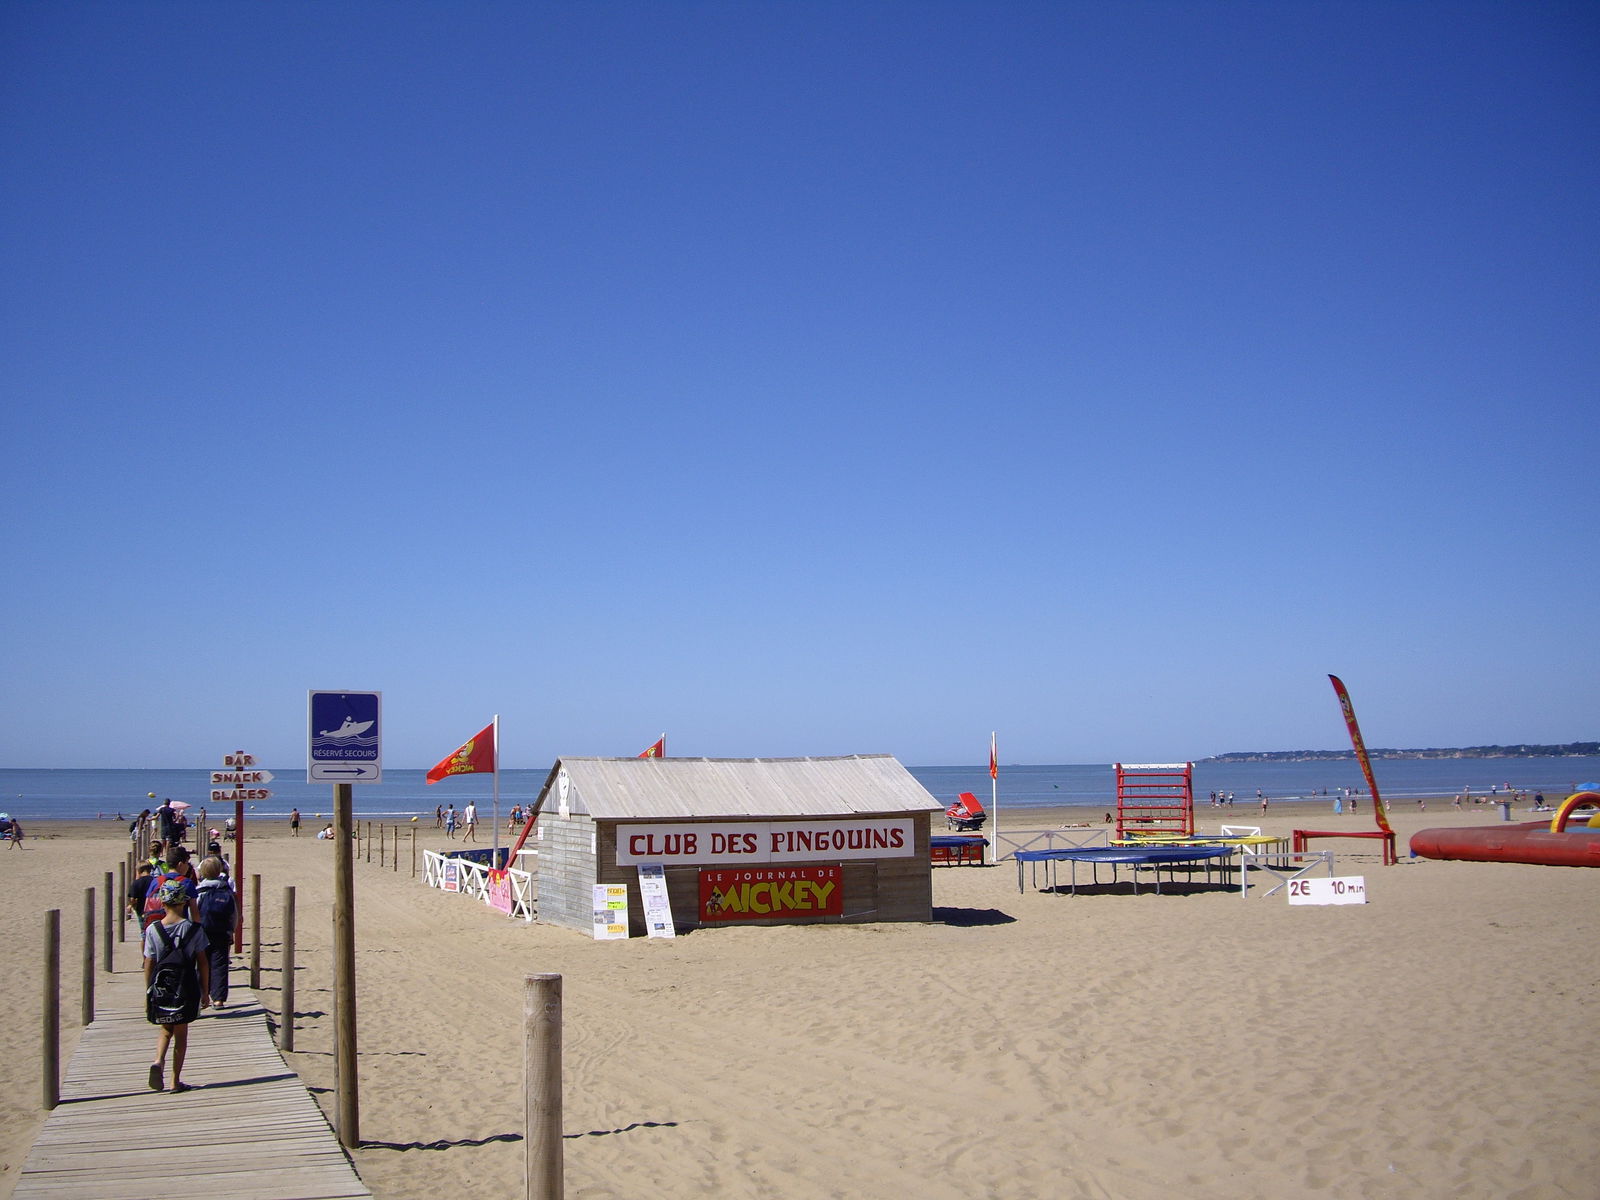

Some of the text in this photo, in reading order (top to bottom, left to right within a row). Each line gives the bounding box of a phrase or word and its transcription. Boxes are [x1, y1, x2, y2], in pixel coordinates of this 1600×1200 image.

[224, 755, 253, 766] BAR
[212, 772, 262, 783] SNACK
[212, 789, 269, 801] GLACES
[629, 828, 904, 856] CLUB DES PINGOUINS
[707, 869, 834, 882] LE JOURNAL DE
[1290, 880, 1311, 896] 2€
[1331, 880, 1345, 895] 10
[706, 880, 836, 914] MICKEY
